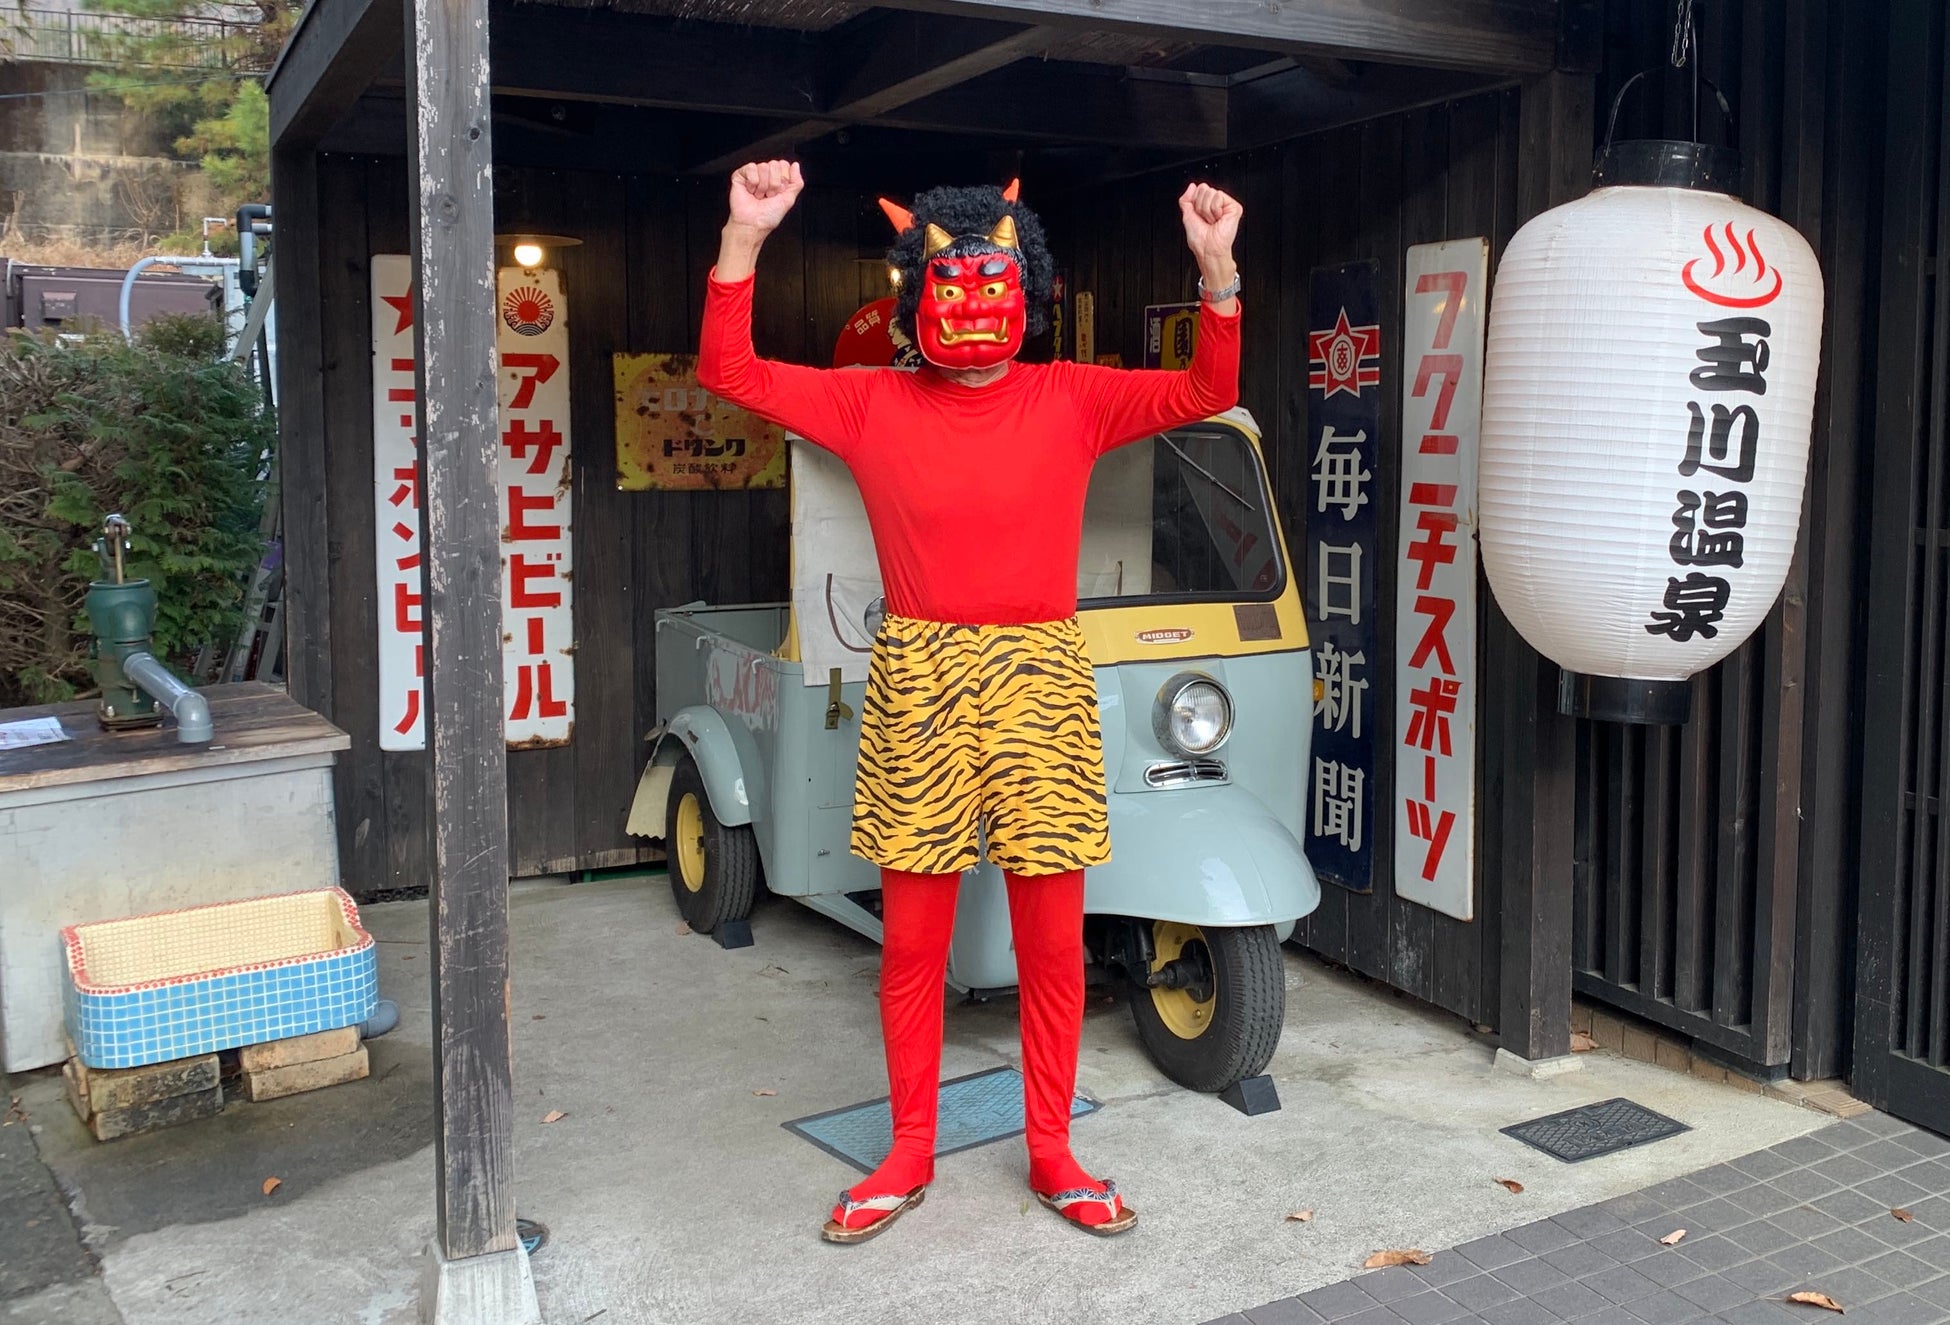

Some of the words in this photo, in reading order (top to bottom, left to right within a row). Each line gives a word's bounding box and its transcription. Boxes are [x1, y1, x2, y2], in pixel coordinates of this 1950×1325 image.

[501, 352, 567, 720] アサヒビール
[1142, 631, 1188, 640] MIDGET
[1311, 425, 1372, 853] 毎日新聞
[1404, 271, 1468, 882] フクニチスポーツ
[1644, 316, 1772, 643] 玉川温泉
